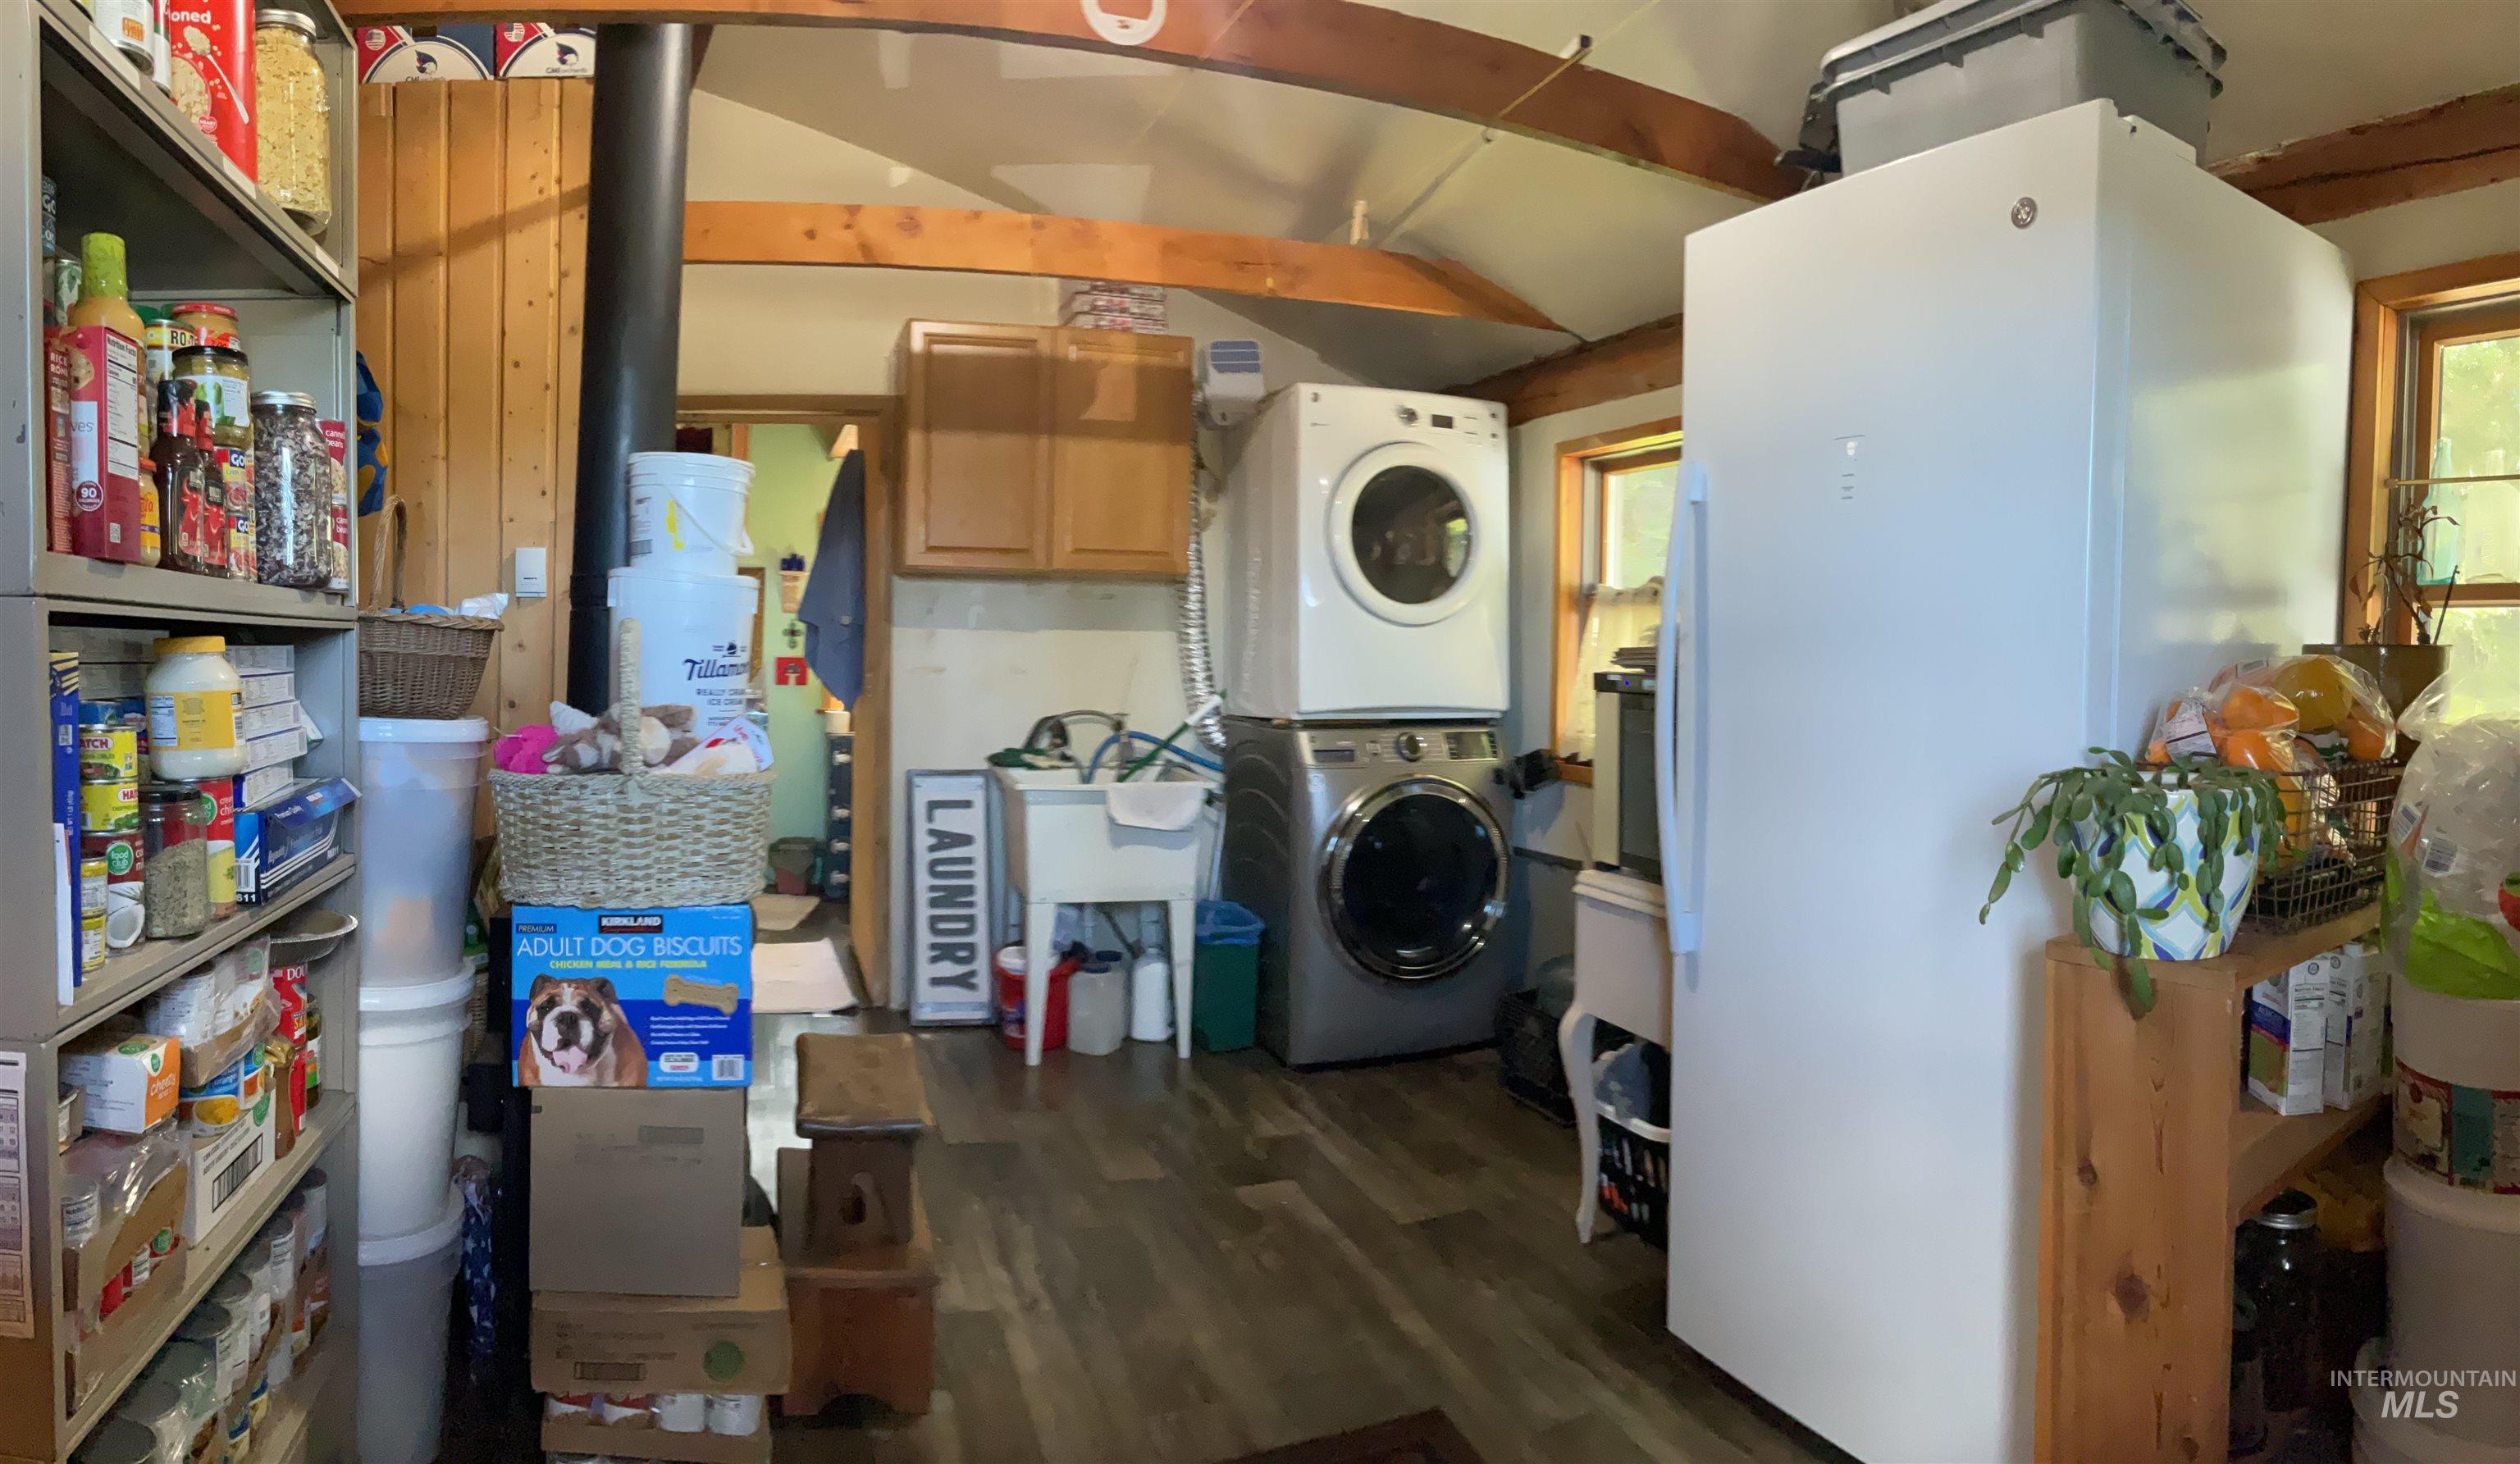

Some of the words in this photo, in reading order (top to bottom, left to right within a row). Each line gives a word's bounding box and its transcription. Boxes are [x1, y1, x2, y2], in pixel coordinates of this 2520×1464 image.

[80, 487, 97, 498] 90
[926, 799, 979, 993] LAUNDRY
[518, 924, 555, 933] PREMIUM
[600, 916, 662, 926] KIRKLAND
[516, 937, 584, 957] ADULT
[591, 937, 646, 956] DOG
[652, 936, 743, 956] BISCUITS
[550, 960, 593, 969] CHICKEN
